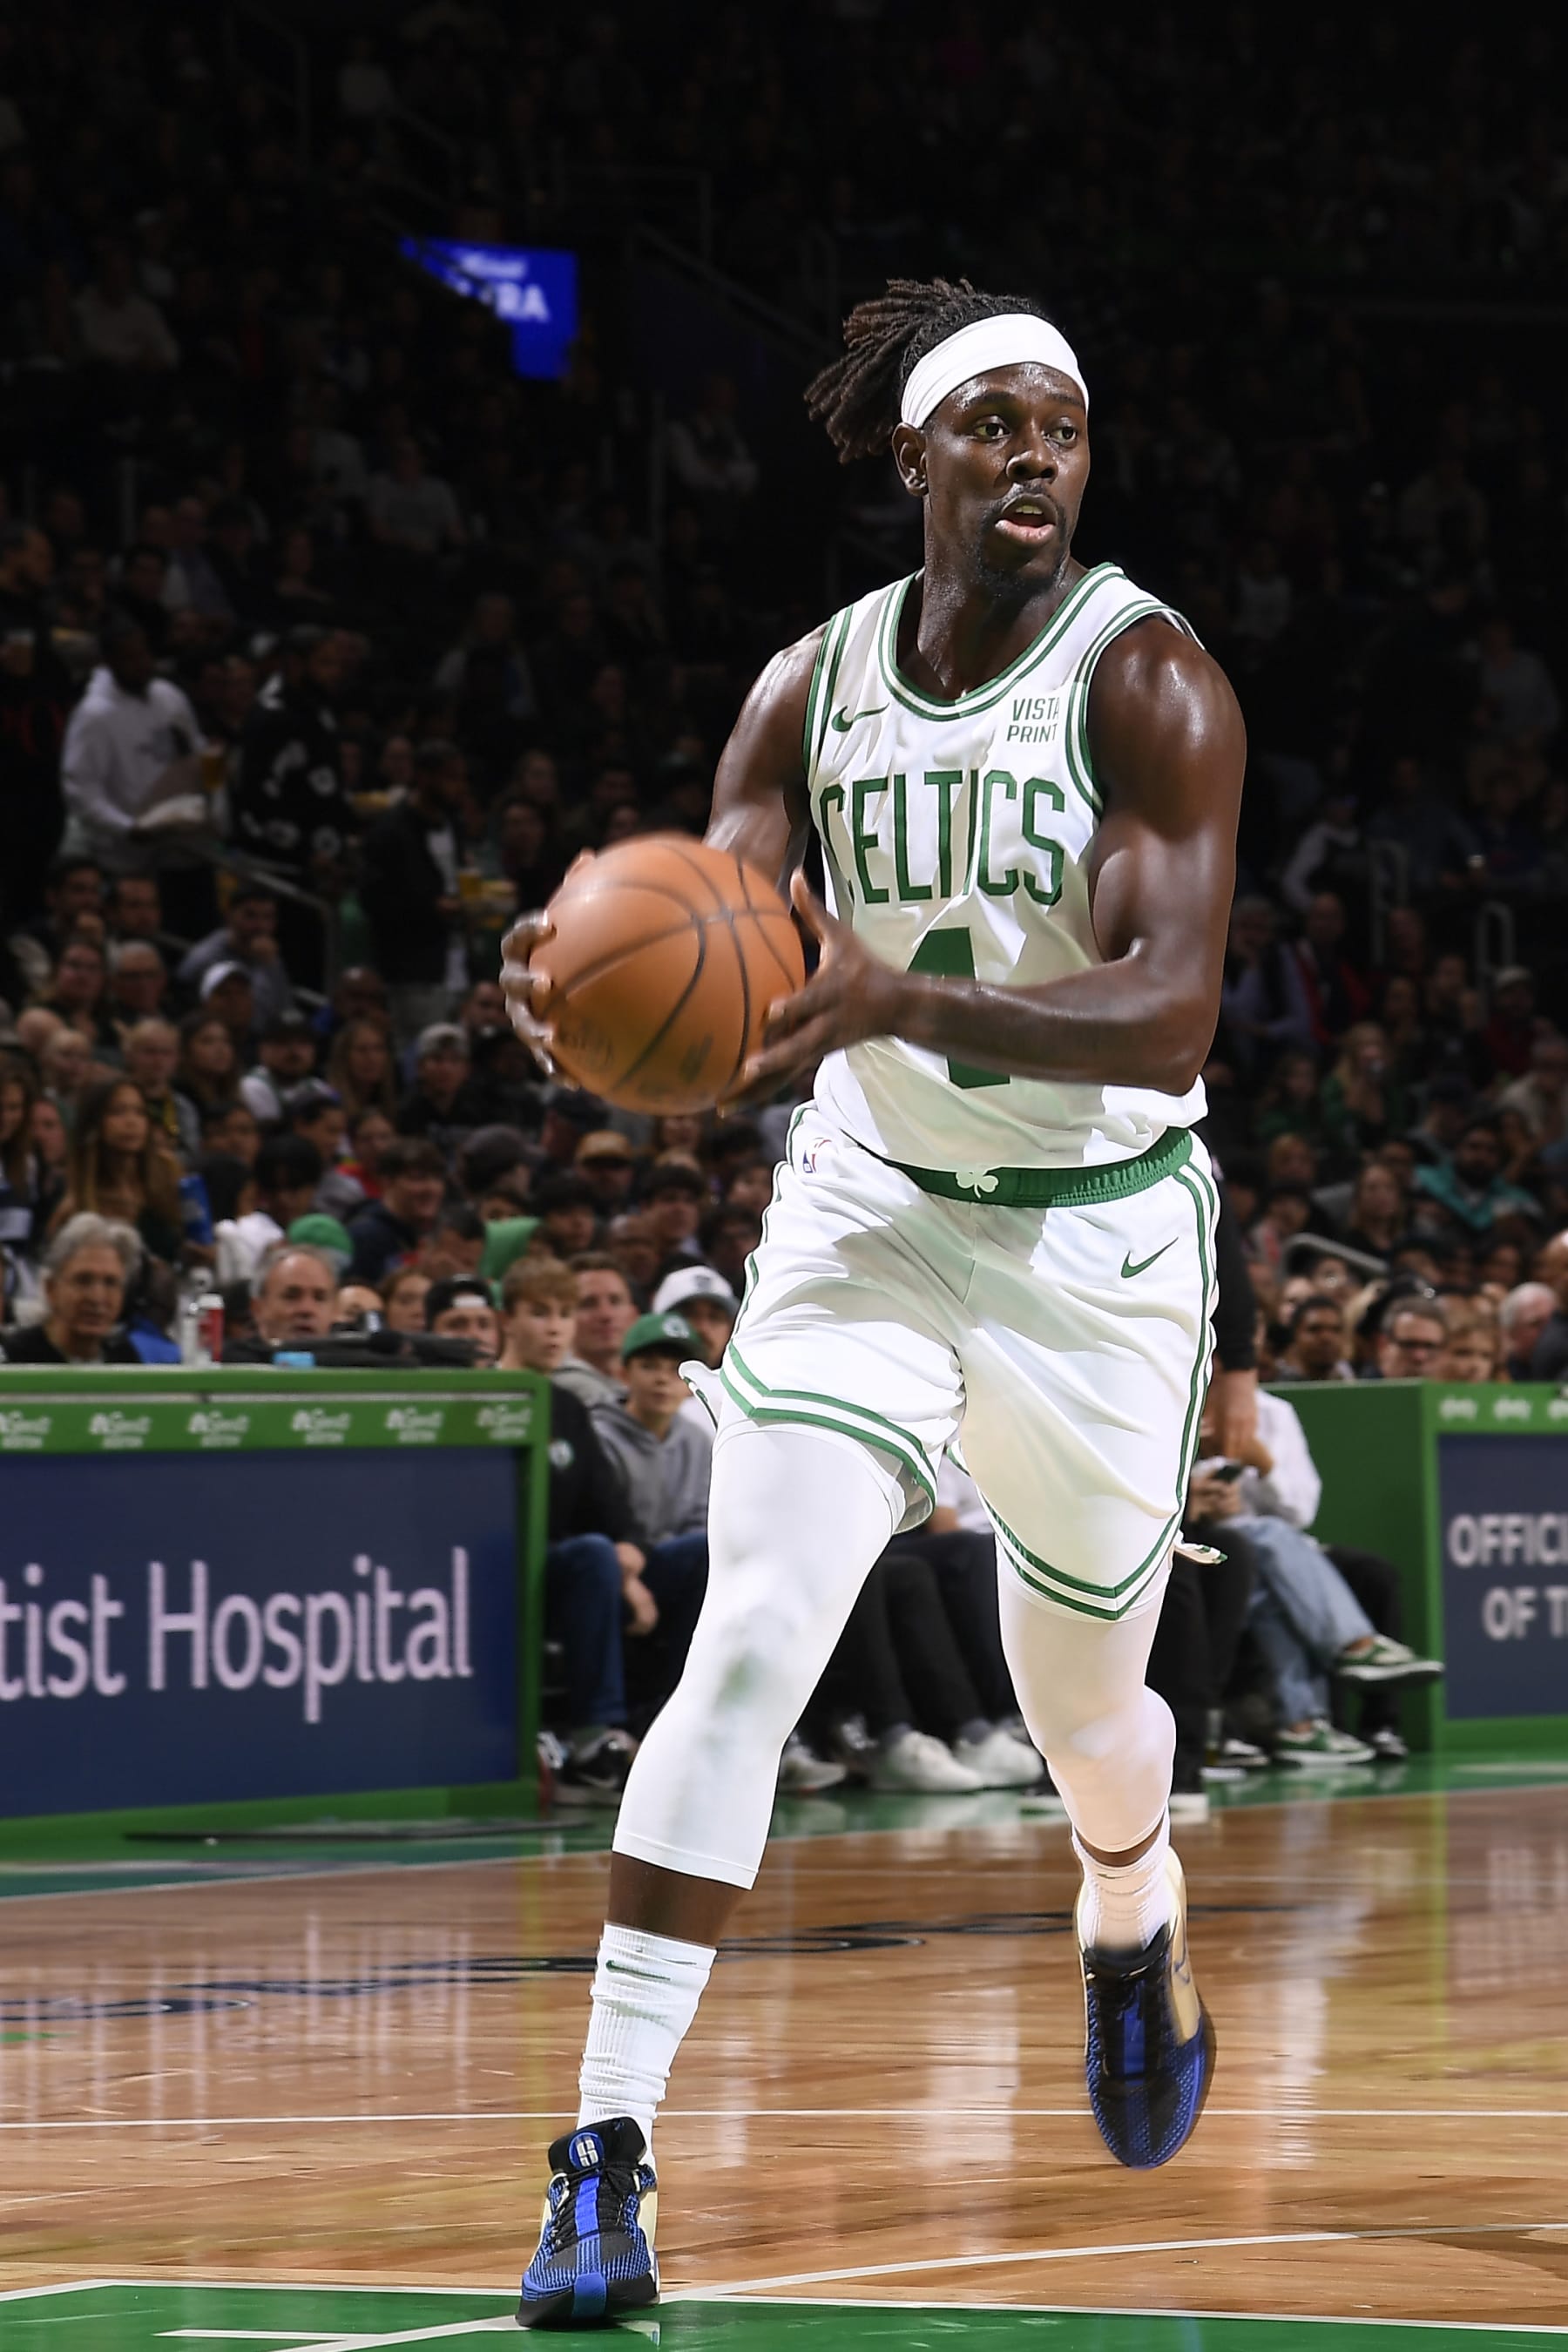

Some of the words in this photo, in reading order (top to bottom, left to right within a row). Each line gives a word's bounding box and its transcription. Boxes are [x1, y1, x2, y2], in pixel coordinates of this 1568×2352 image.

[820, 768, 1065, 906] CELTICS
[148, 1546, 473, 1724] Hospital
[1482, 1586, 1538, 1640] OF
